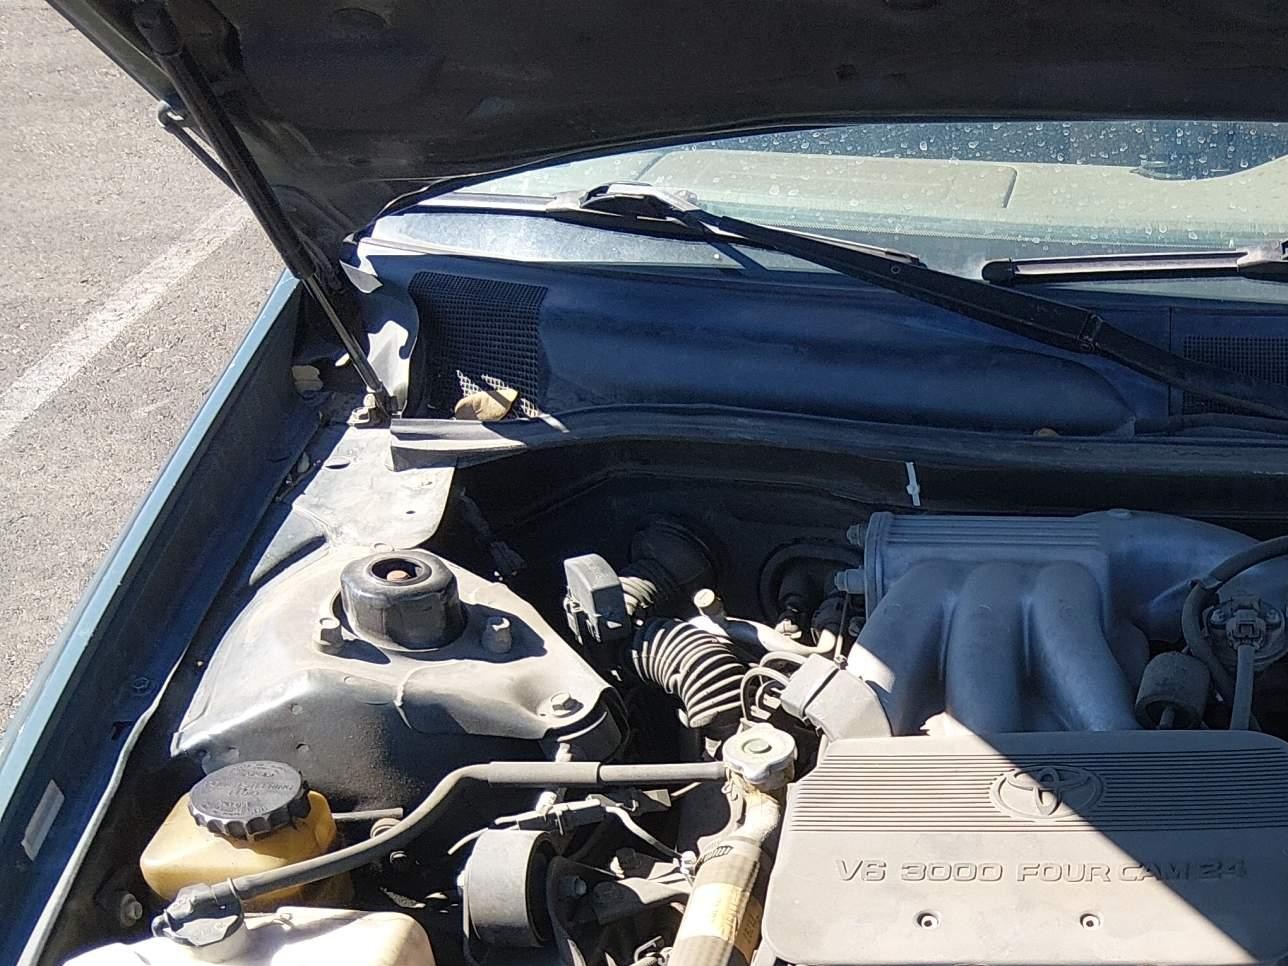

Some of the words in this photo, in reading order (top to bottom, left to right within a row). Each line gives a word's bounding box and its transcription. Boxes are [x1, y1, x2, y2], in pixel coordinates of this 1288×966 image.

[836, 860, 887, 882] V6
[901, 862, 1003, 882] 3000
[1016, 862, 1110, 883] FOUR
[1119, 861, 1190, 882] CAM
[1201, 860, 1247, 880] 24
